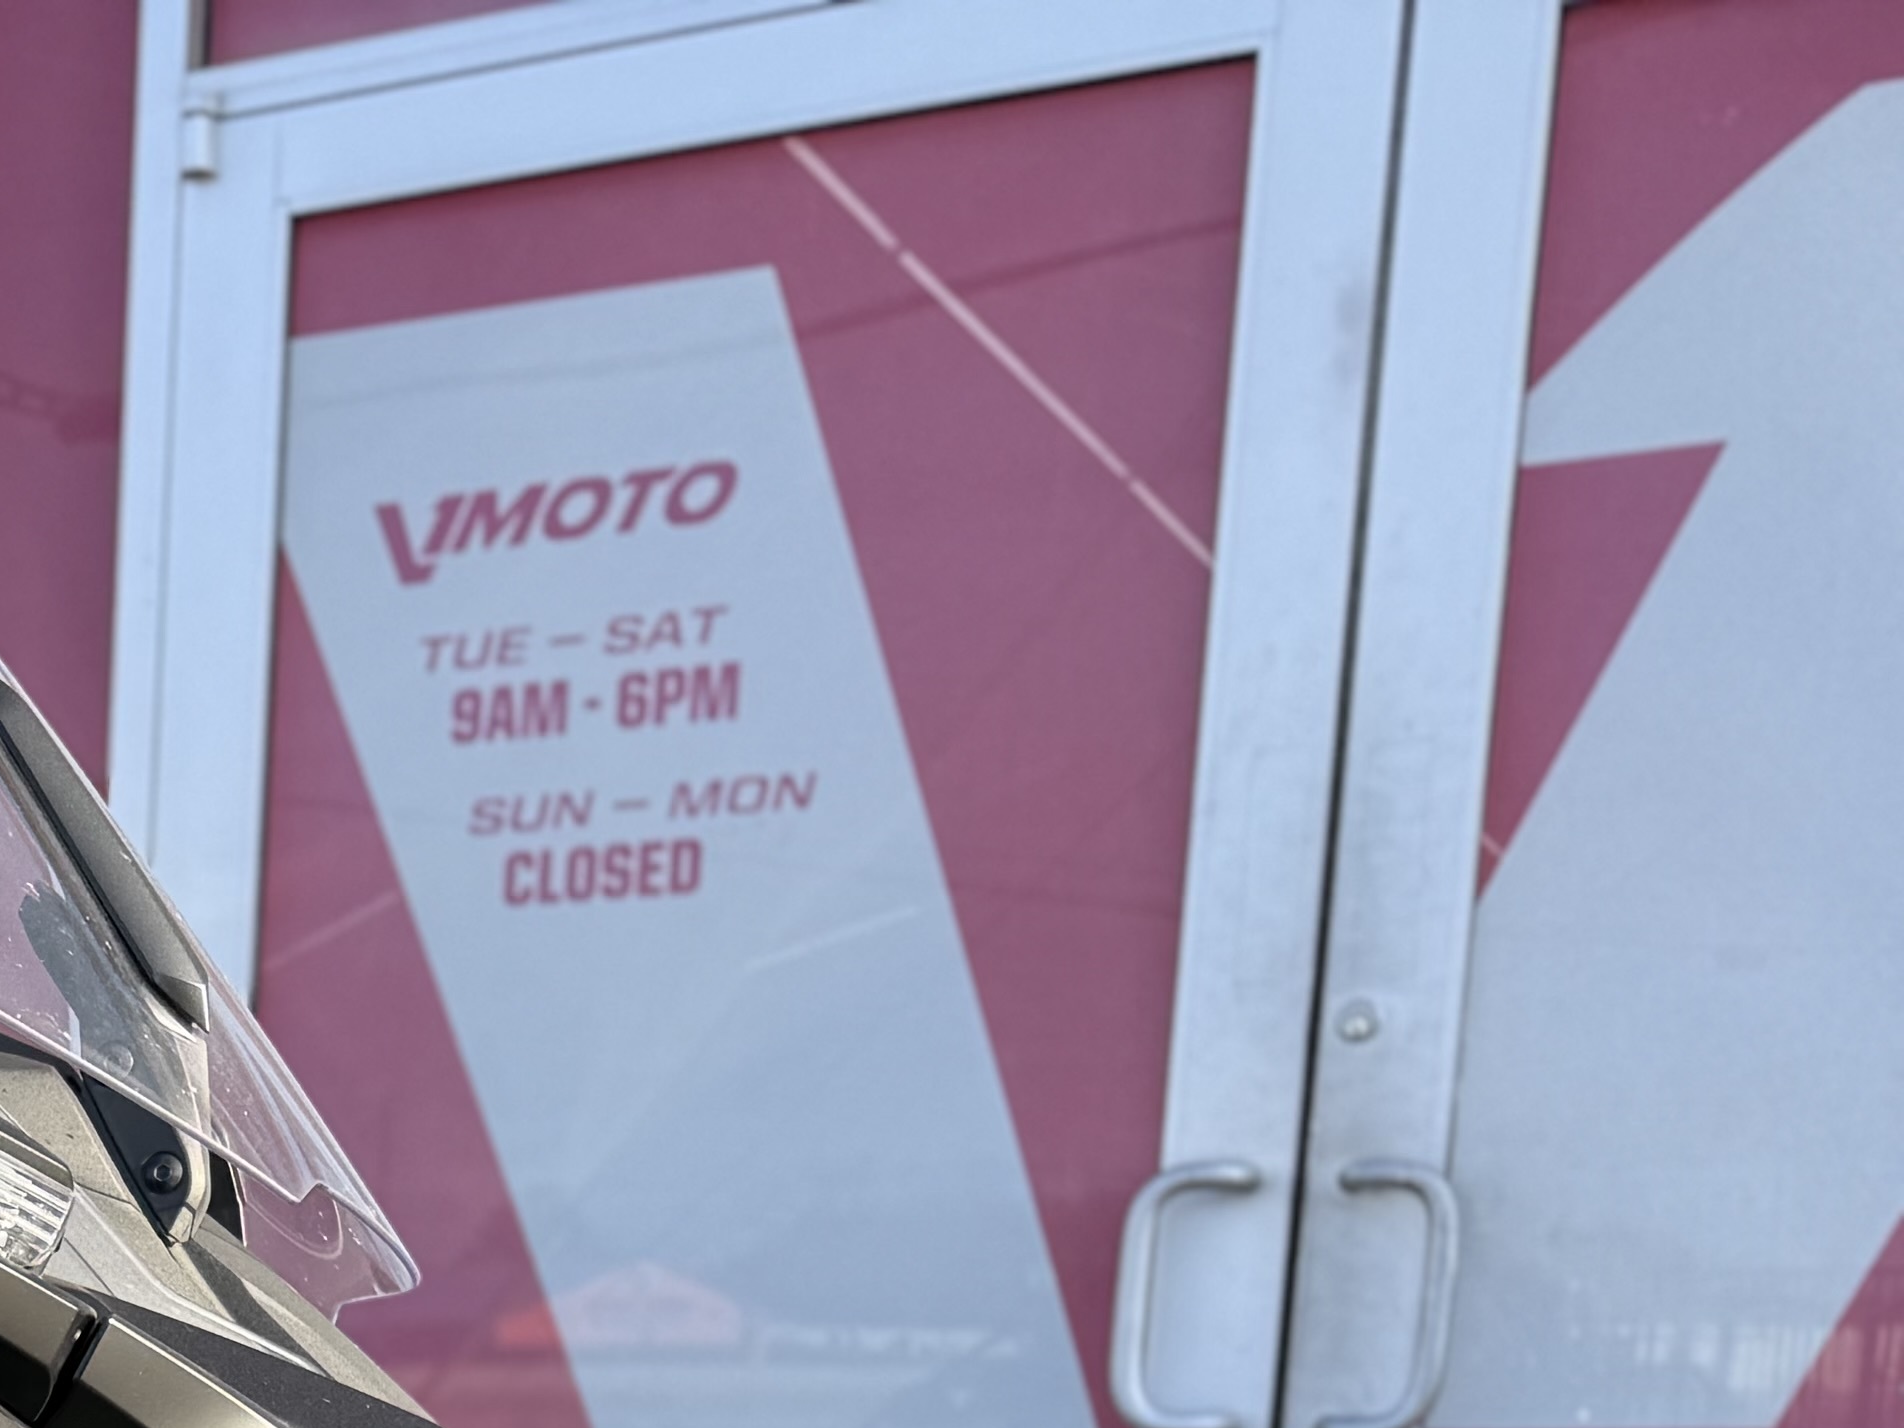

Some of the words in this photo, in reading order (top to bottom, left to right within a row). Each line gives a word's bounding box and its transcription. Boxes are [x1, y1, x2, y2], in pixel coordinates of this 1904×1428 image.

[420, 625, 532, 673] TUE
[603, 604, 730, 655] SAT
[451, 678, 569, 744] 9AM
[615, 661, 741, 729] 6PM
[467, 788, 595, 836] SUN
[667, 770, 818, 820] MON
[501, 836, 703, 906] CLOSED
